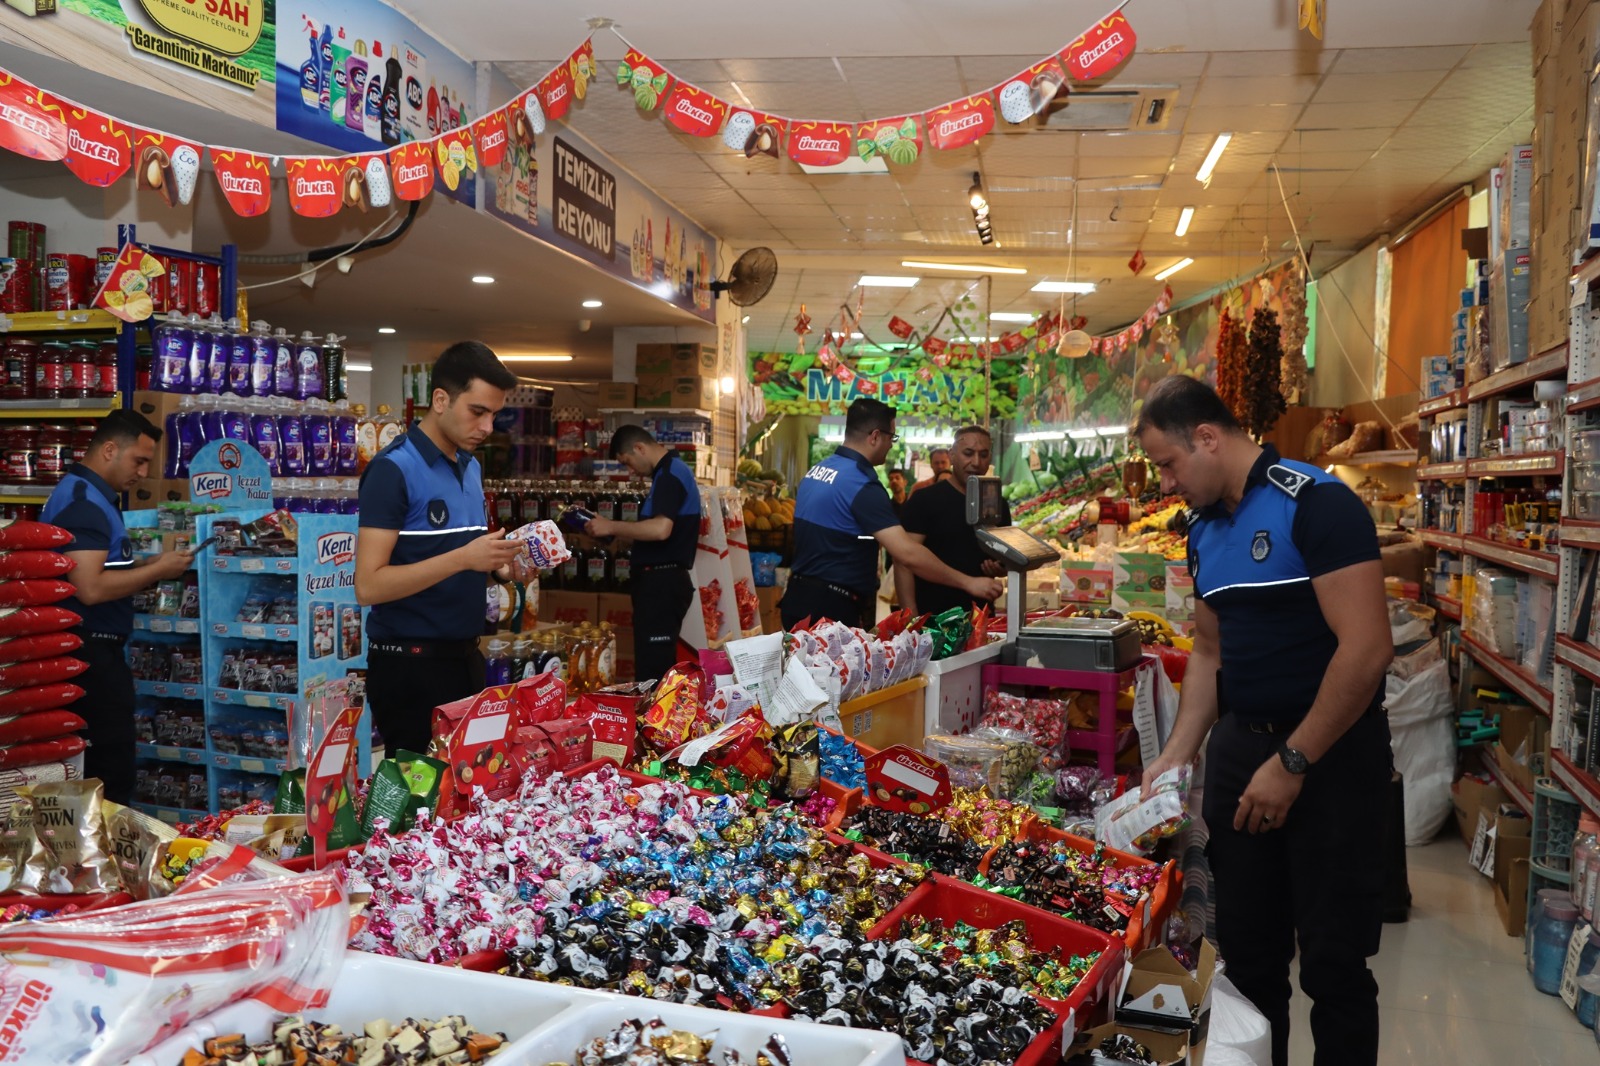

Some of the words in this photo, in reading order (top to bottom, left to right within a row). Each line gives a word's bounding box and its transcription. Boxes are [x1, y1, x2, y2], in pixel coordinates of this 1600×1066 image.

[181, 6, 210, 22] QUALITY
[210, 18, 236, 34] CEYLON
[237, 28, 250, 38] TEA
[1079, 32, 1124, 69] ÜLKER
[407, 82, 422, 105] ABC
[676, 97, 713, 126] ÜLKER
[0, 106, 50, 139] LKER
[939, 112, 984, 137] ÜLKER
[69, 130, 120, 166] ÜLKER
[480, 130, 505, 152] ÜLKER
[798, 136, 840, 152] ÜLKER
[222, 172, 262, 195] ÜLKER
[399, 164, 428, 184] ÜLKER
[296, 178, 336, 196] ÜLKER
[558, 197, 611, 254] REYONU
[168, 342, 181, 350] ABC
[262, 426, 273, 434] ABC
[196, 475, 229, 492] Kent
[237, 475, 261, 490] Lezzet
[804, 465, 839, 485] ZABITA
[320, 537, 353, 558] Kent
[305, 573, 336, 595] Lezzet
[478, 700, 508, 716] ÜLKER
[592, 712, 628, 724] NAPOLITEN
[896, 754, 935, 777] ÜLKER
[40, 808, 75, 828] OWN
